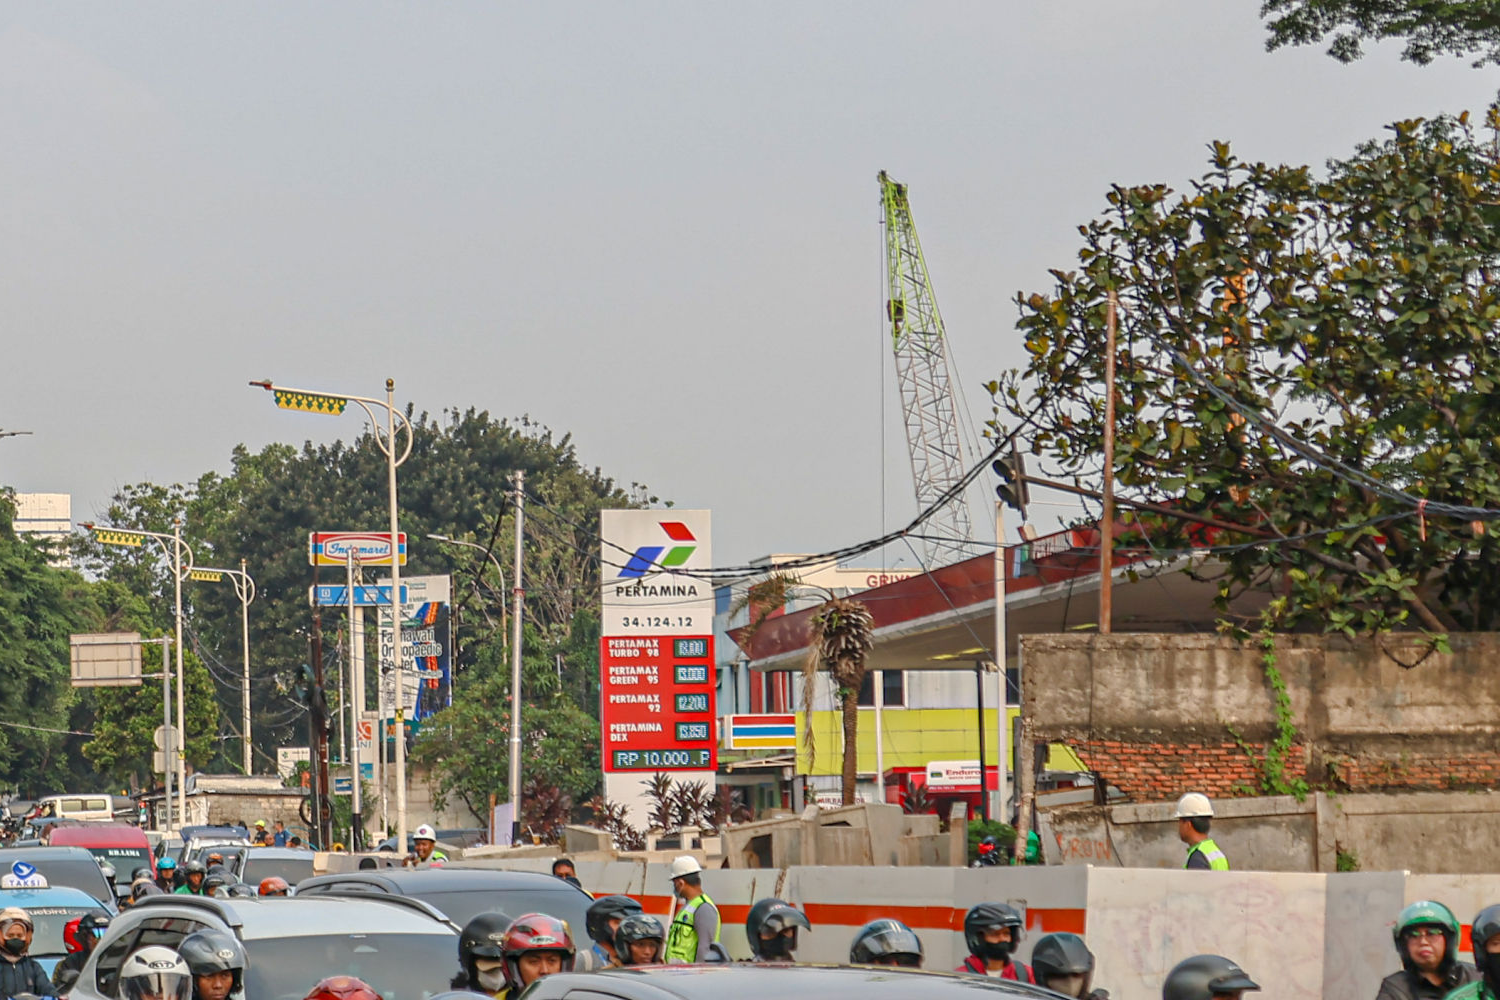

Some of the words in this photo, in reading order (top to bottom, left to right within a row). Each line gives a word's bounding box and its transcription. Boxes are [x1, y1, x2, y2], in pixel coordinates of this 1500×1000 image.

[866, 574, 911, 588] GRI
[616, 585, 698, 597] PERTAMINA
[622, 616, 693, 628] 34.124.12
[608, 639, 659, 648] PERTAMAX
[609, 648, 640, 657] TURBO
[646, 648, 660, 657] 98
[609, 666, 659, 675] PERTAMAX
[609, 676, 639, 685] GREEN
[647, 675, 659, 684] 95
[610, 694, 660, 703] PERTAMAX
[648, 704, 661, 712] 92
[610, 723, 662, 732] PERTAMINA
[610, 733, 628, 742] DEX
[617, 752, 639, 766] RP
